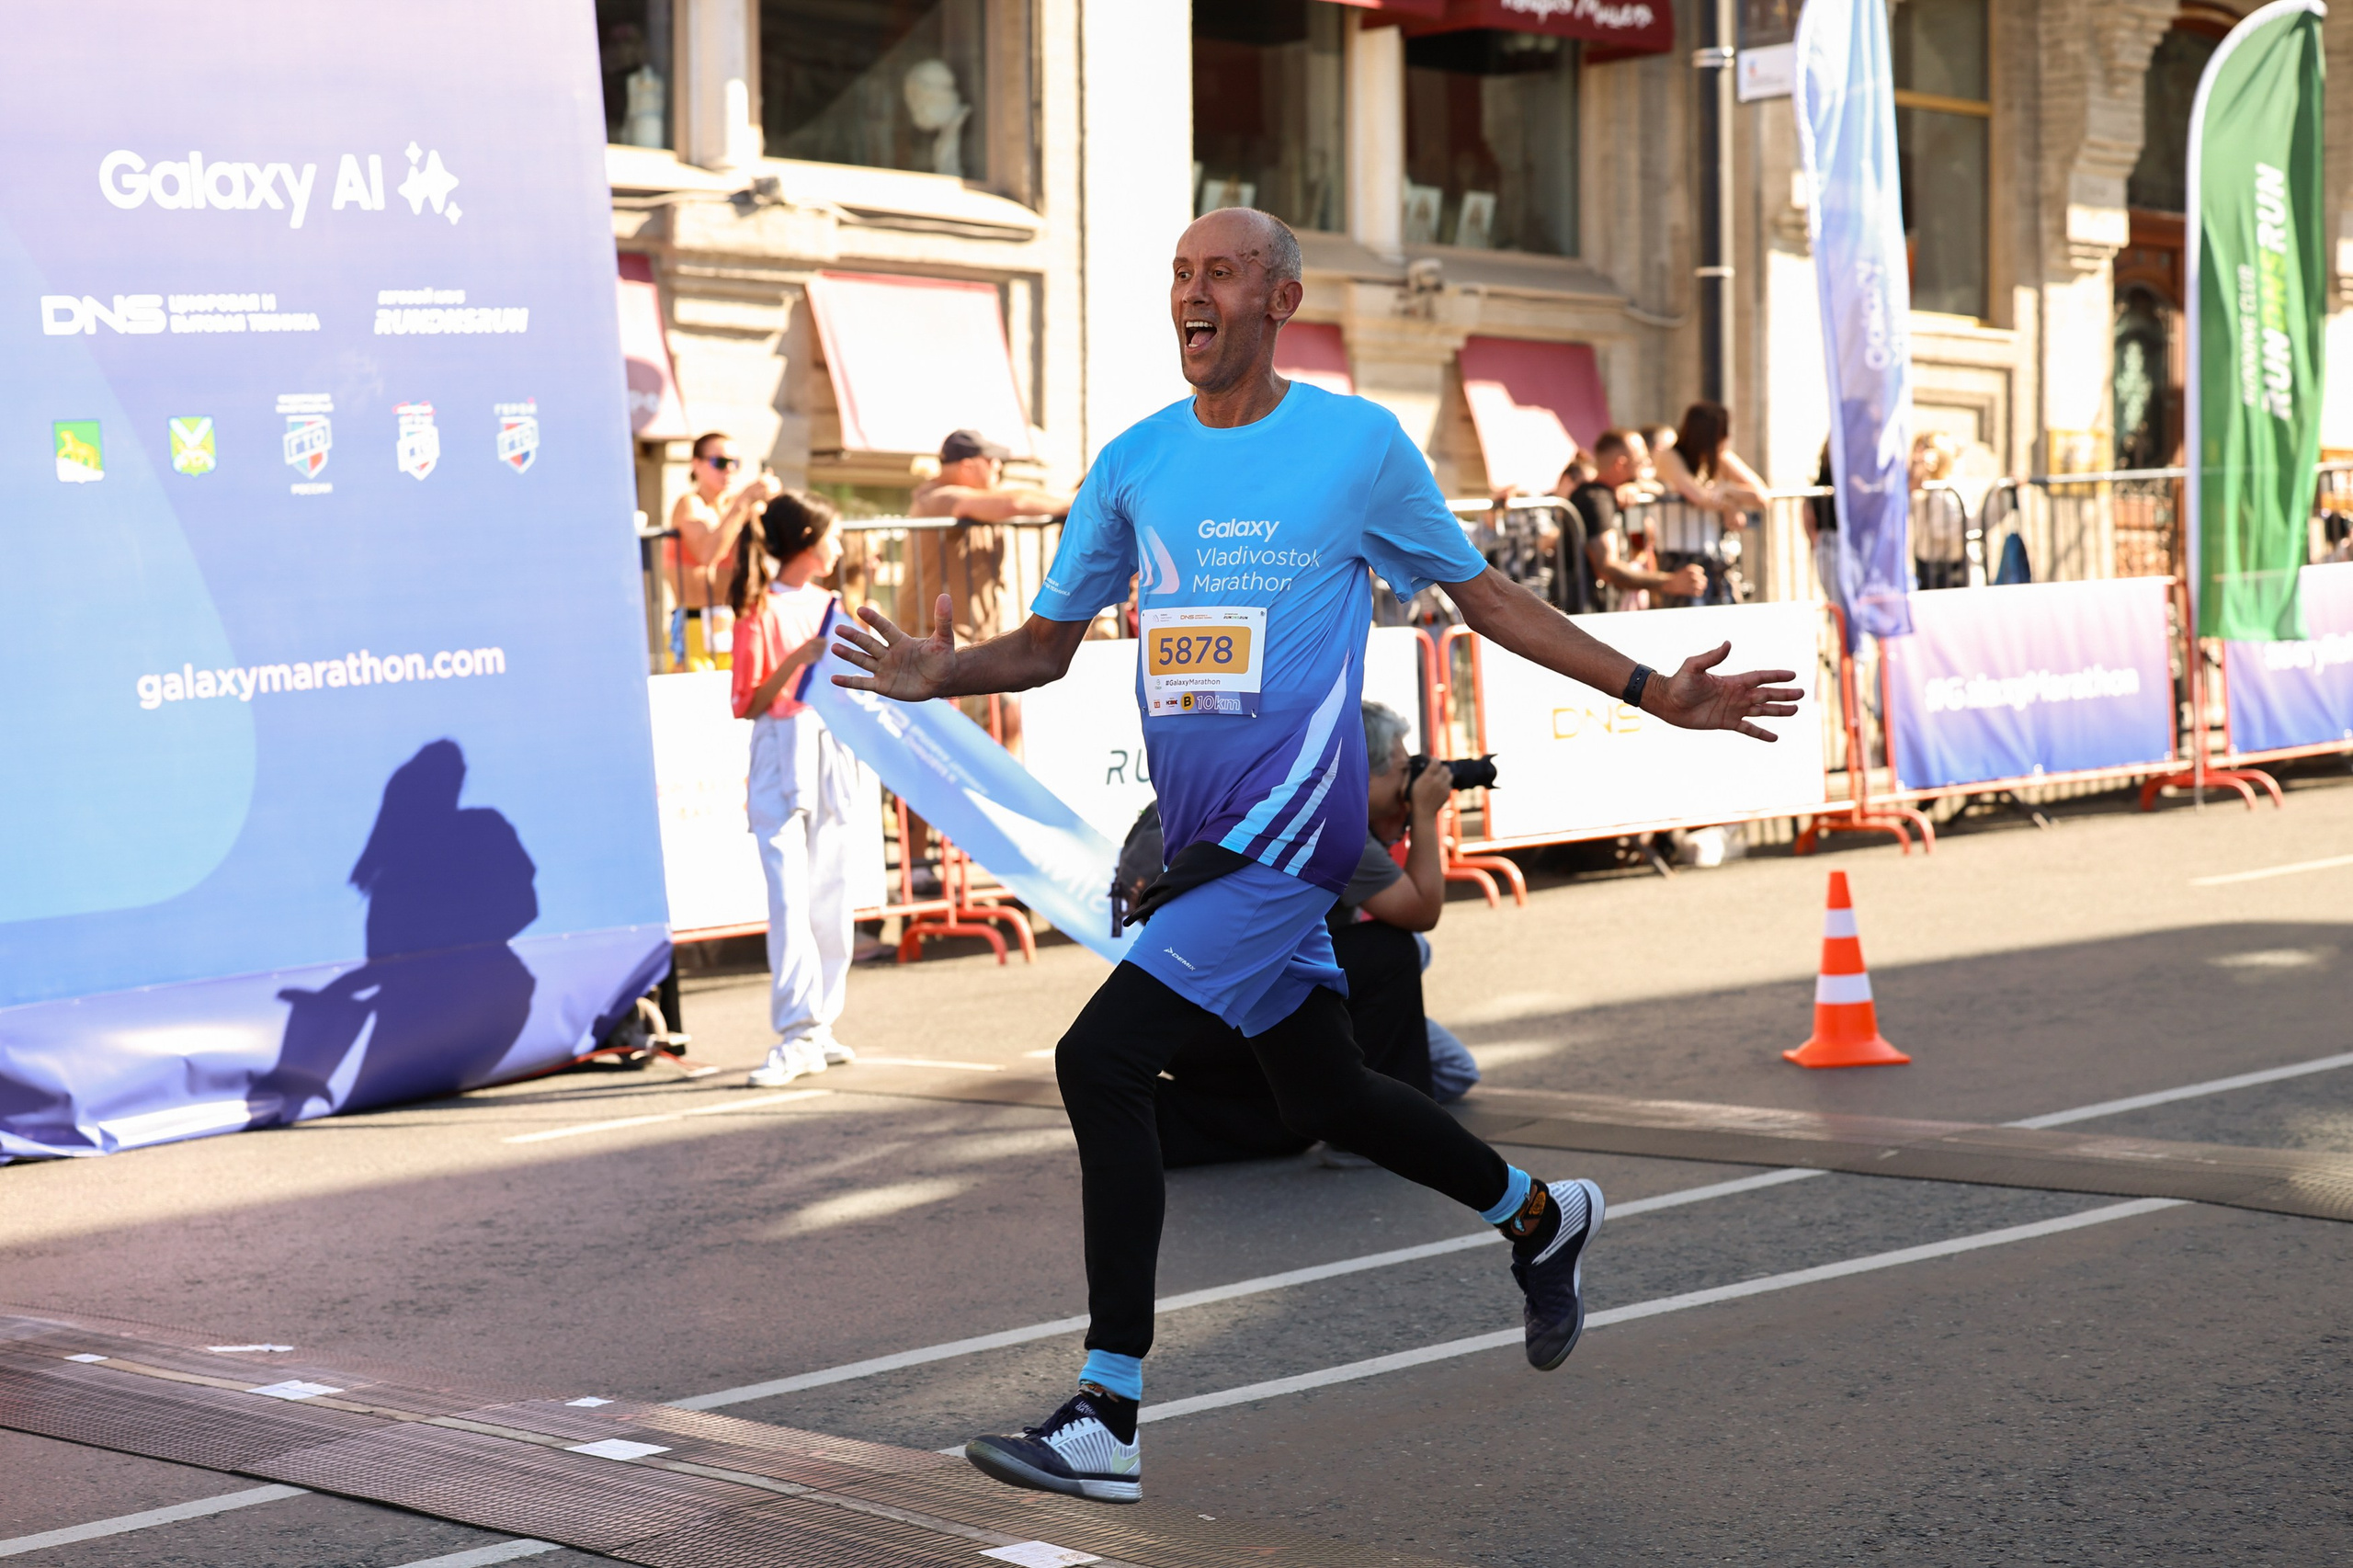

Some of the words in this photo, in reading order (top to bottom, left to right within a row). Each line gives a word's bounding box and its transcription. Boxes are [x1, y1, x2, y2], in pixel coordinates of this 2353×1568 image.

[98, 149, 317, 230] Galaxy
[331, 153, 386, 211] AI
[40, 294, 167, 335] DNS
[1198, 518, 1279, 542] Galaxy
[1196, 546, 1323, 567] Vladivostok
[1193, 572, 1292, 593] Marathon
[1159, 636, 1233, 665] 5878
[137, 646, 506, 710] galaxymarathon.com
[1165, 678, 1221, 687] #GalaxyMarathon
[1197, 695, 1240, 710] 10km
[1552, 702, 1643, 740] DNS
[1172, 952, 1196, 971] DEMIX
